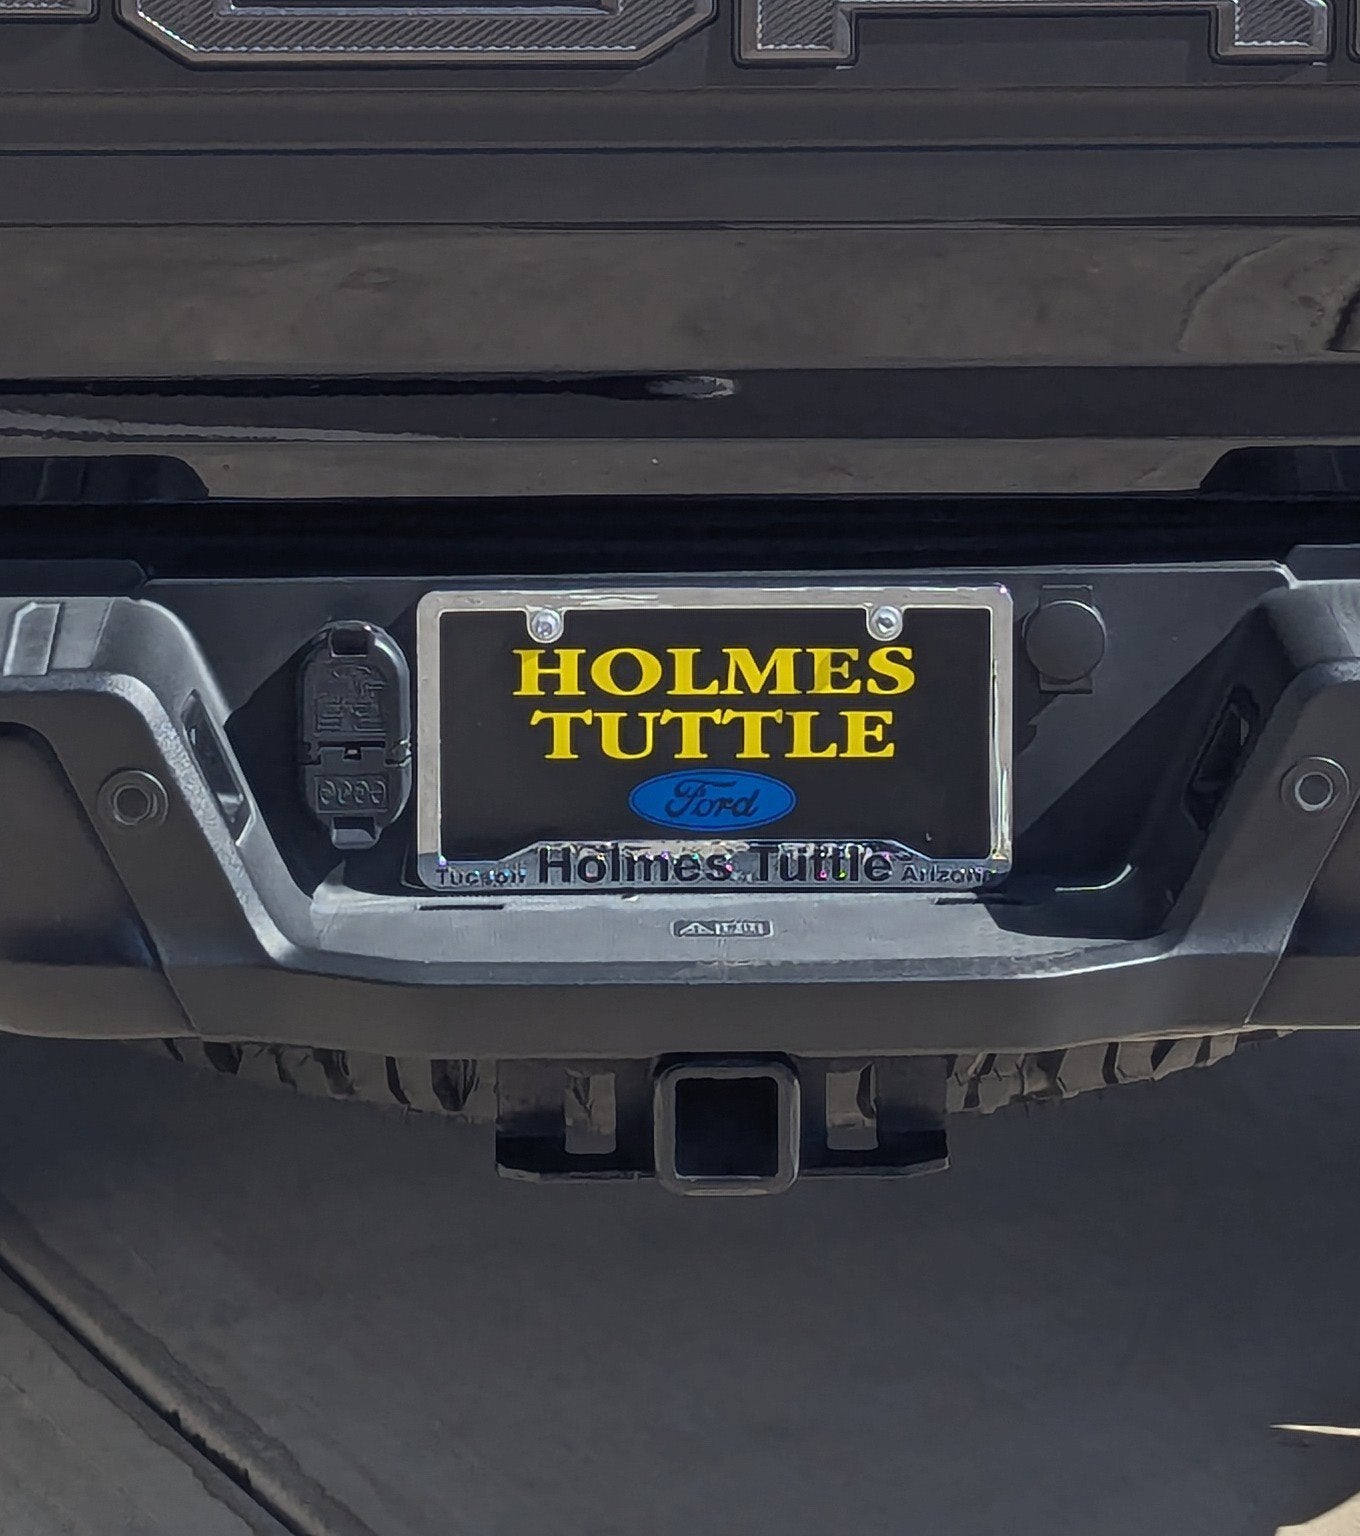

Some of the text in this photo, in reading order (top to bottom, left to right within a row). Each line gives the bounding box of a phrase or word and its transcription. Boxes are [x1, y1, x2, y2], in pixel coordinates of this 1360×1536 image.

[512, 646, 915, 696] HOLMES
[530, 709, 895, 759] TUTTLE
[664, 778, 761, 818] Ford
[539, 843, 892, 884] Holmes Tuttle
